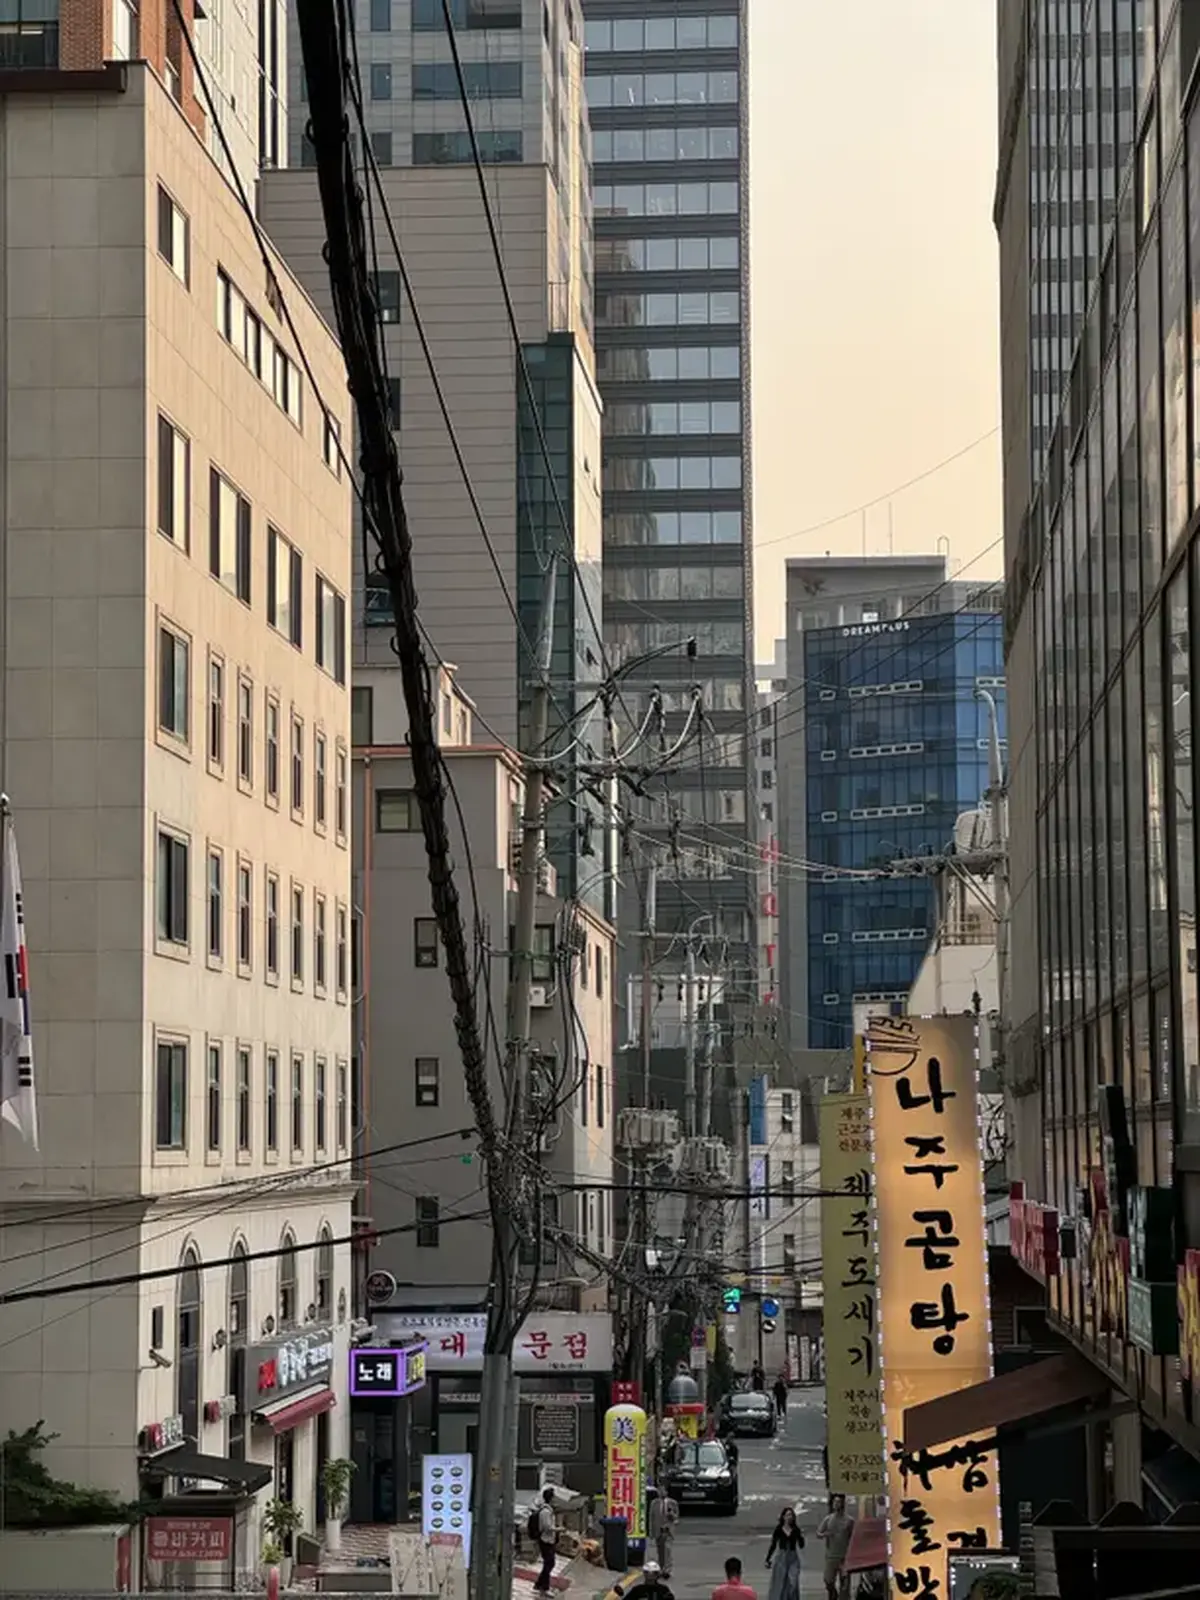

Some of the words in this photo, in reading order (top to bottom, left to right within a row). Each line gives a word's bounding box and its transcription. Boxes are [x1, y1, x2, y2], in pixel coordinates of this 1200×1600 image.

[842, 621, 910, 637] DREAMPLUS
[895, 1056, 970, 1355] 나주곰탕
[358, 1362, 392, 1382] 노래
[611, 1416, 637, 1444] 美
